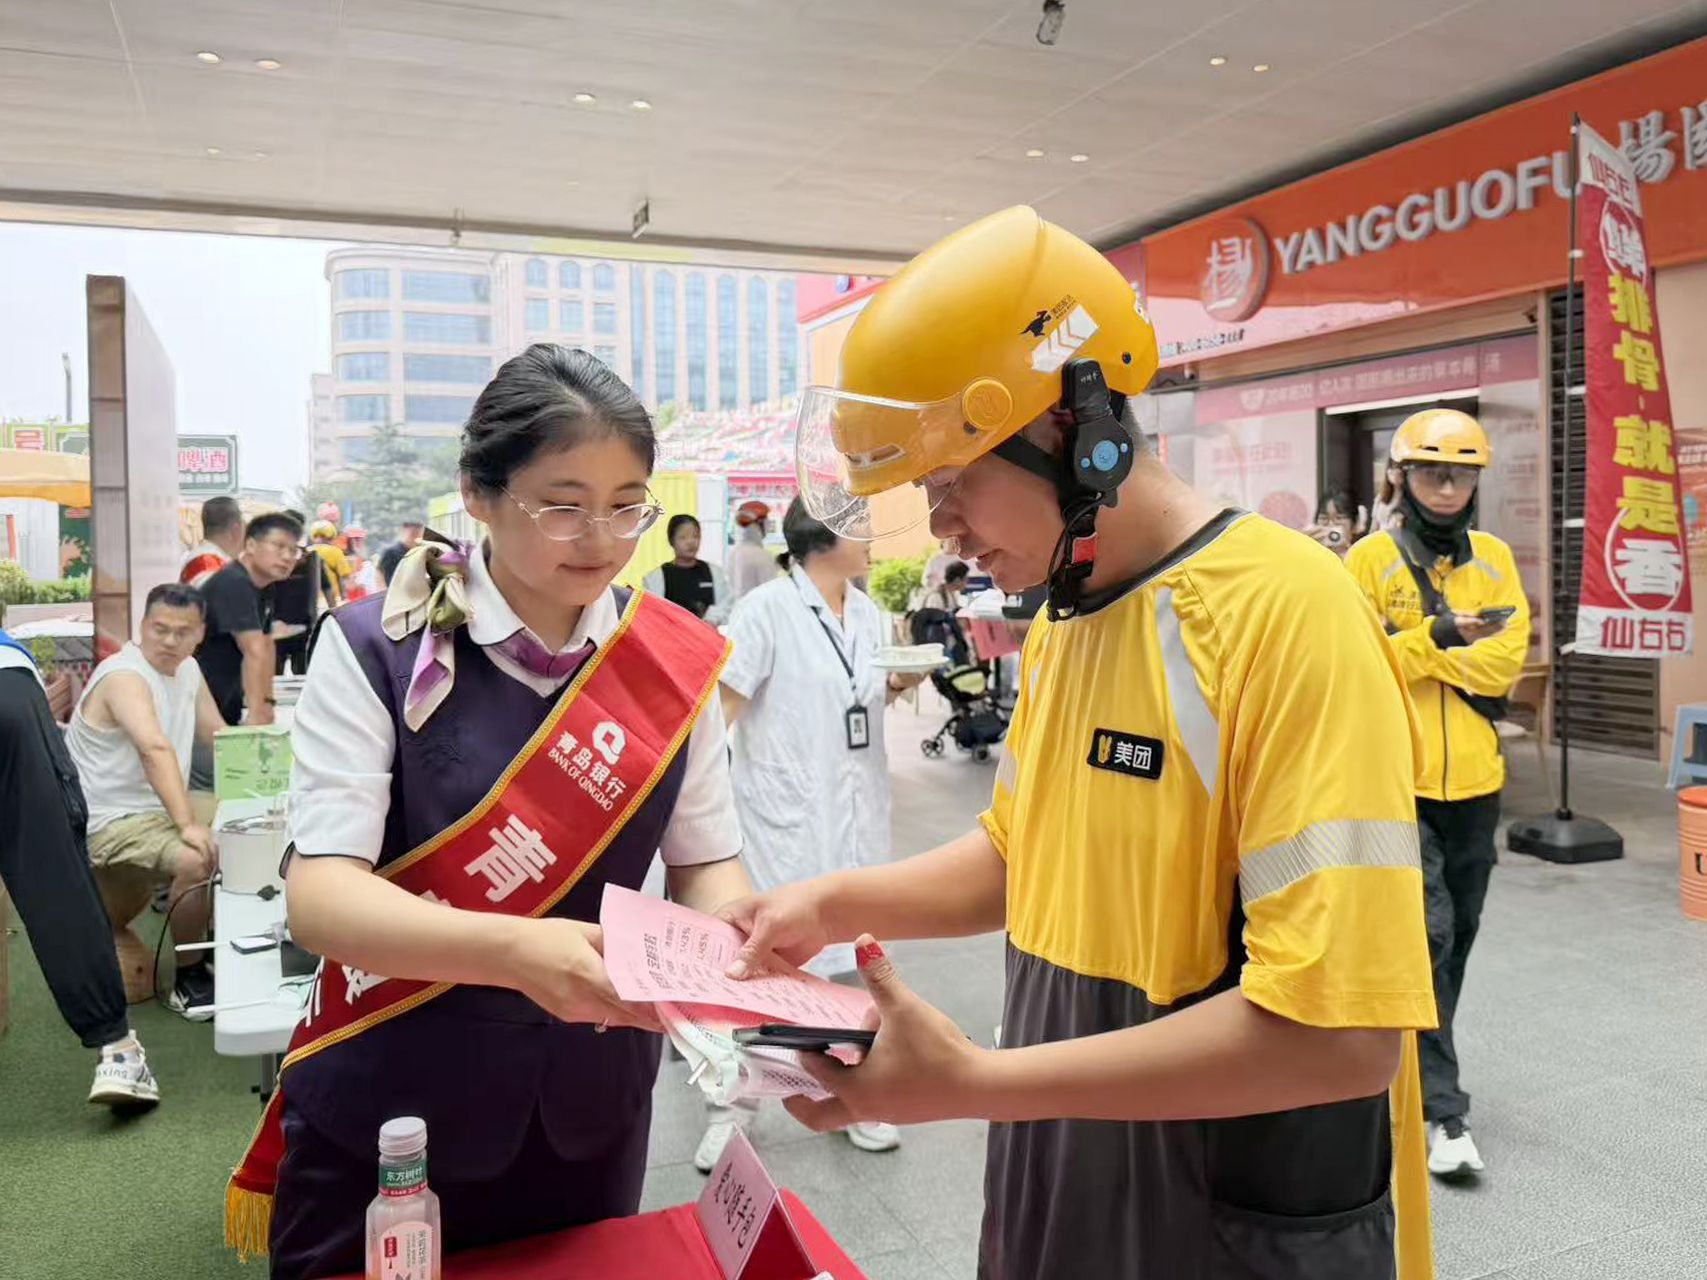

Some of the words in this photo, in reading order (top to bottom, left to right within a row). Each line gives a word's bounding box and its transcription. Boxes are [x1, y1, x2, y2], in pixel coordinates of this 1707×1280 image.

[1274, 150, 1582, 275] YANGGUOFU
[547, 747, 571, 772] BANK
[568, 765, 582, 779] OF
[578, 775, 614, 812] QINGDAO
[556, 731, 627, 799] 青岛银行
[1114, 741, 1152, 770] 美团
[385, 1166, 423, 1182] 东方树叶
